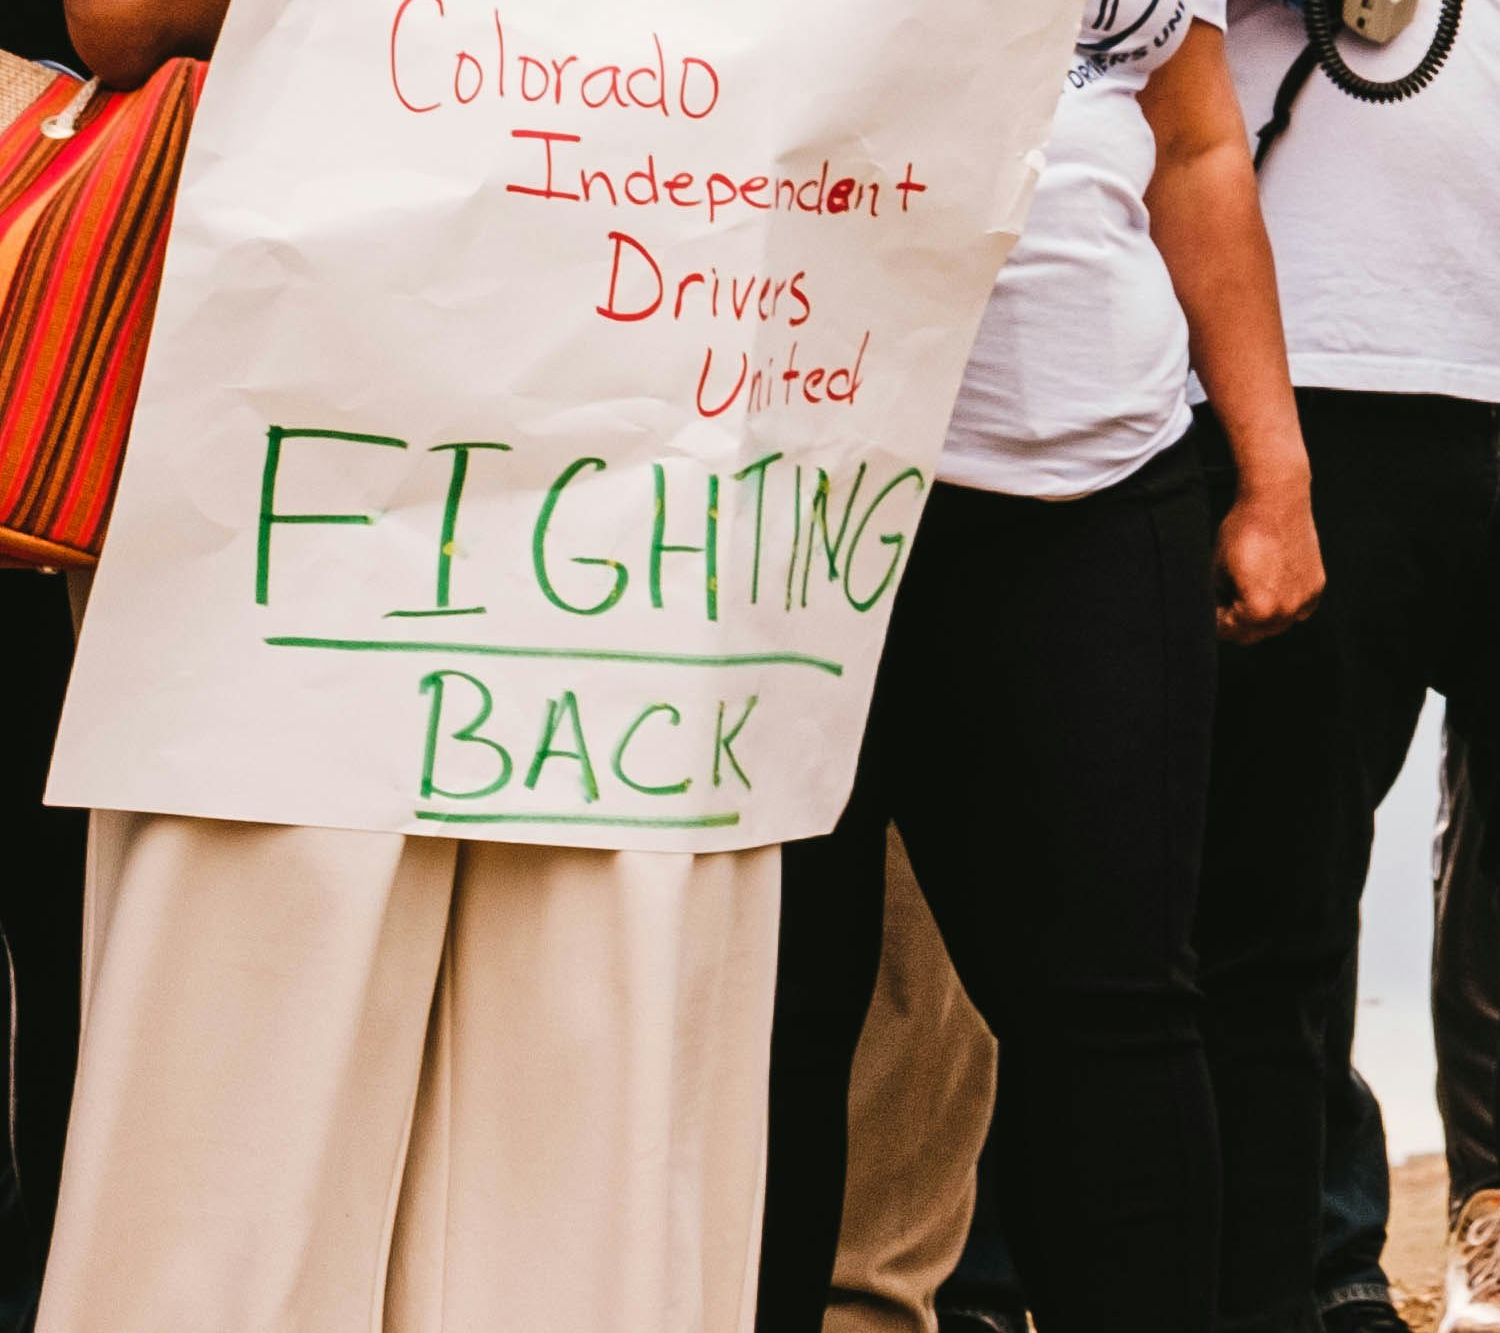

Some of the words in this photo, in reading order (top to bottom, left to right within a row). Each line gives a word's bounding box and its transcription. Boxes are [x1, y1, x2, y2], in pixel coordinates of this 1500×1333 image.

[505, 129, 928, 223] Independent
[593, 232, 813, 325] Drivers
[694, 331, 871, 420] United
[253, 423, 928, 622] FIGHTING
[418, 669, 762, 802] BACK
